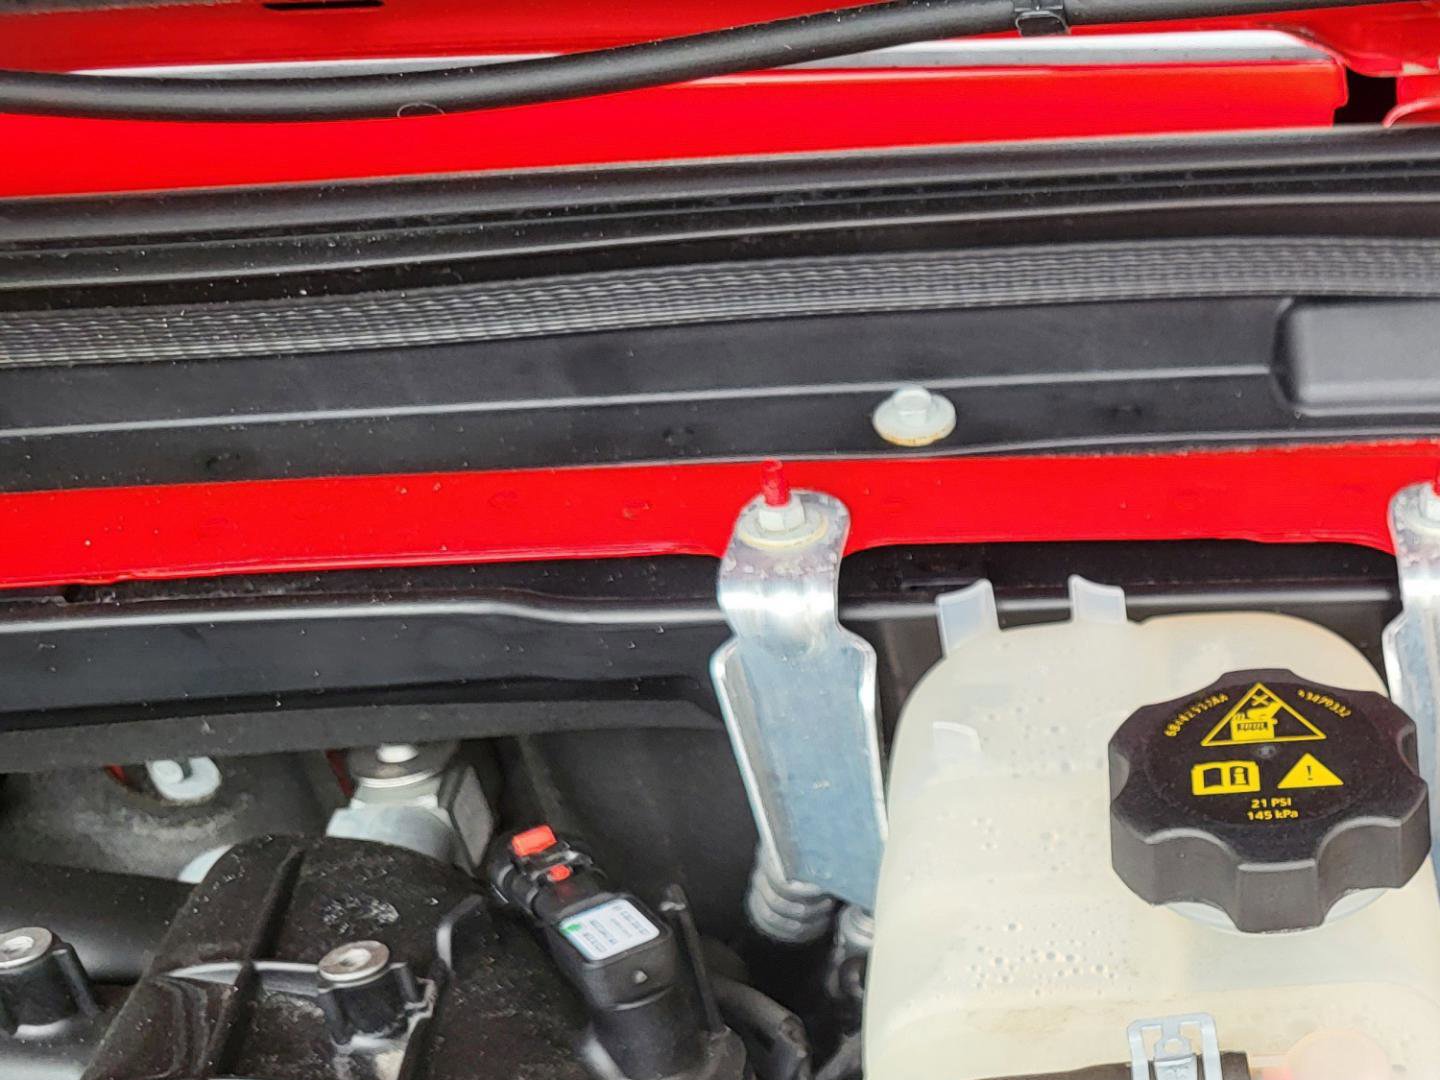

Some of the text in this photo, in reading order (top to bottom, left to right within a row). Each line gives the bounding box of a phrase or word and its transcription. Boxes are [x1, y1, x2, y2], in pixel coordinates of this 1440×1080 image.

[1251, 797, 1292, 809] 21 PSI
[1247, 808, 1299, 820] 145 kPa
